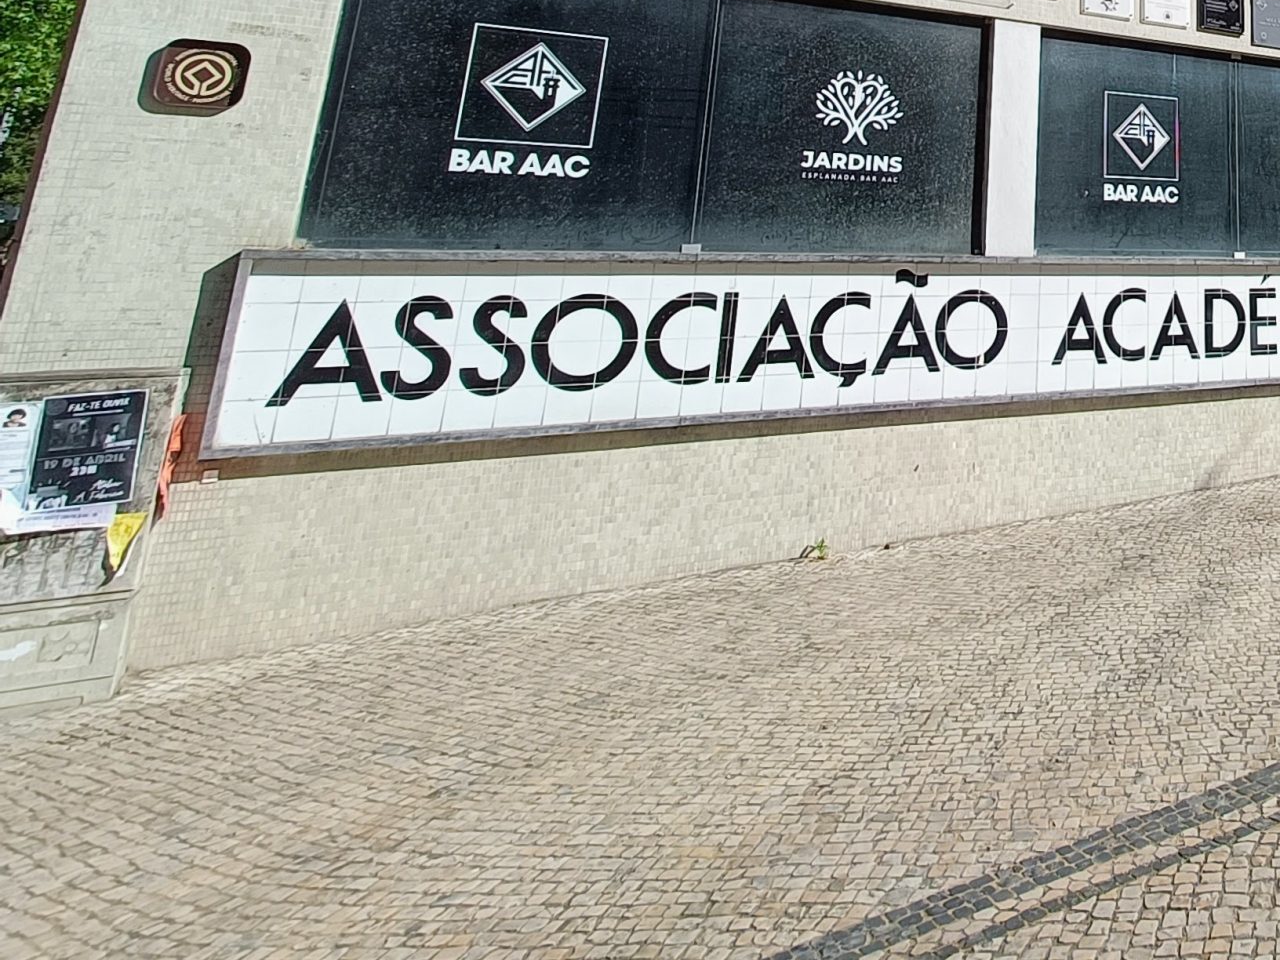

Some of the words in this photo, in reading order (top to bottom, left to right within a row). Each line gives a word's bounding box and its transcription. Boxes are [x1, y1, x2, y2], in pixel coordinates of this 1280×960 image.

[448, 148, 515, 175] BAR
[517, 152, 590, 178] AAC
[800, 150, 903, 173] JARDINS
[801, 171, 856, 181] ESPLANADA
[860, 174, 878, 182] BAR
[1103, 183, 1138, 202] BAR
[1140, 185, 1179, 204] AAC
[264, 267, 1009, 407] ASSOCIAÇÃO
